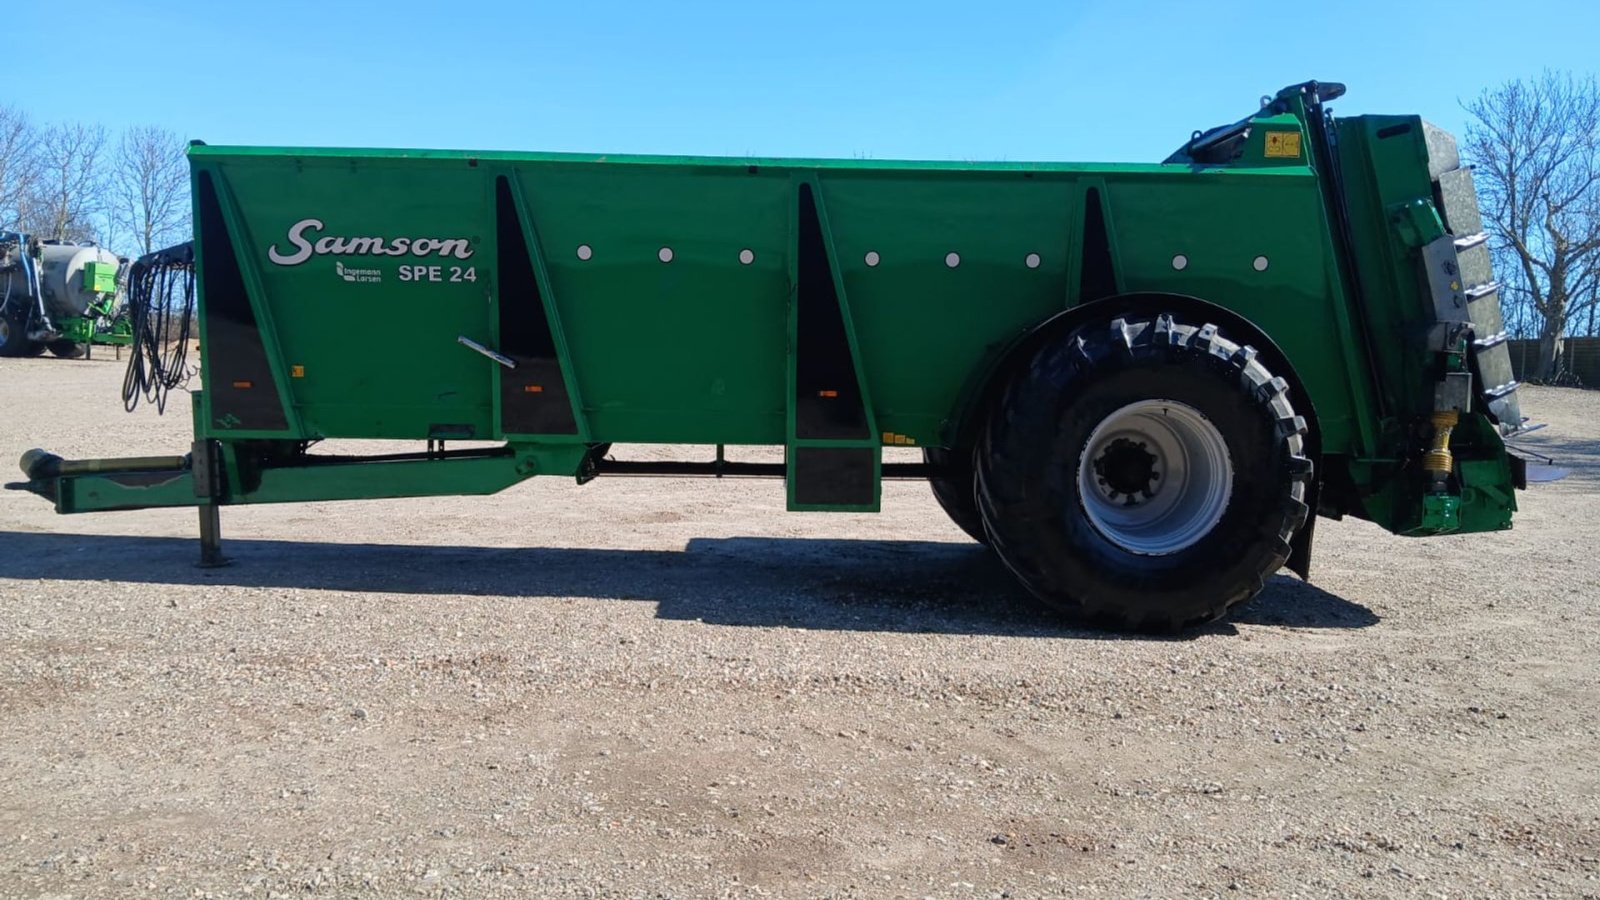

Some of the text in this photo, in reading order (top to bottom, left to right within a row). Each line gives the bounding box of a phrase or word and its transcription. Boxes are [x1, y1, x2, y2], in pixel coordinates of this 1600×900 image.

[268, 218, 473, 266] Samson
[344, 267, 381, 277] Ingemann
[399, 265, 477, 282] SPE 24
[356, 275, 381, 283] Larsen
